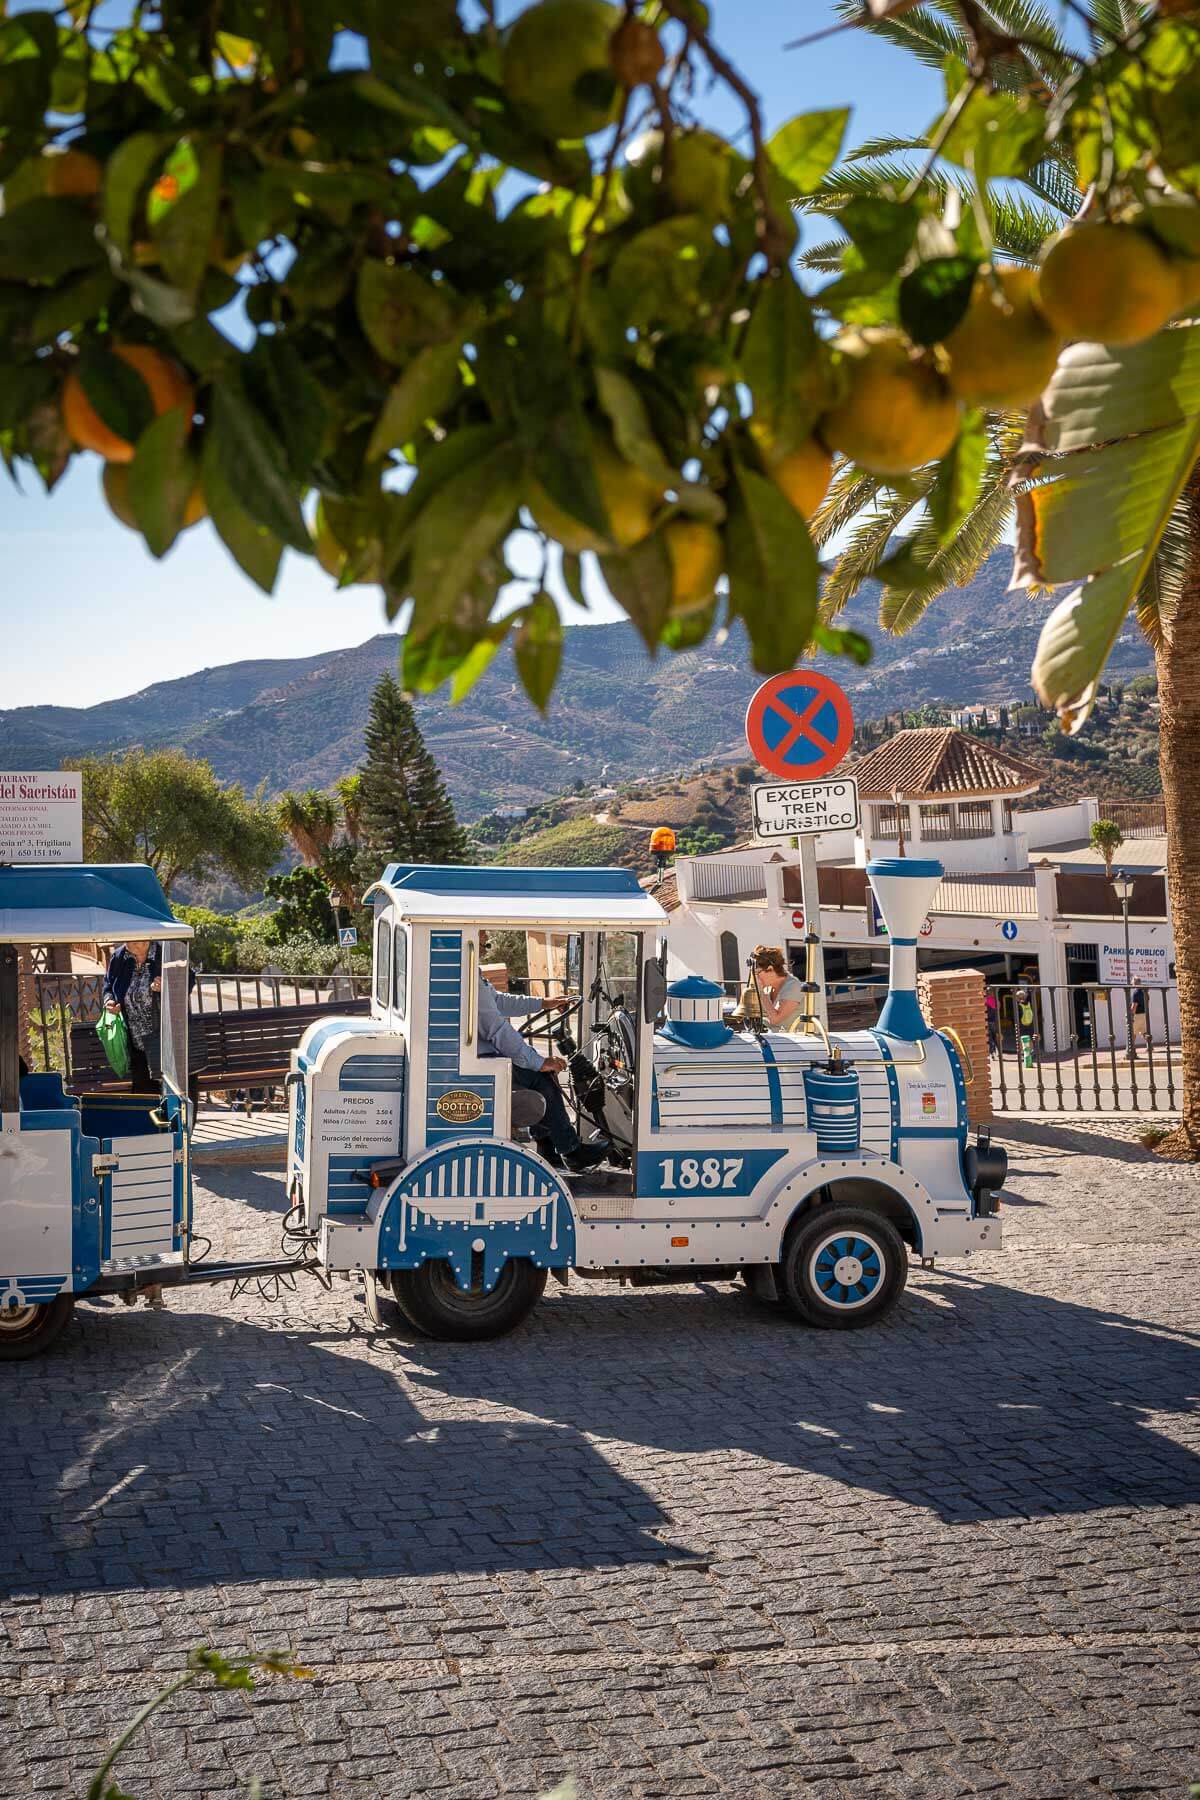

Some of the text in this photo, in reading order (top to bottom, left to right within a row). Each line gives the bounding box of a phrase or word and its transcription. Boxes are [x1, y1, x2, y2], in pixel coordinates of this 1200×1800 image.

[19, 783, 77, 799] Sacristán
[766, 785, 846, 803] EXCEPTO
[782, 801, 827, 815] TREN
[36, 839, 72, 848] Frigiliana
[18, 849, 32, 857] 650
[34, 849, 46, 857] 151
[48, 849, 62, 857] 196
[1104, 945, 1165, 957] PARKIG PUBLICO
[343, 1097, 374, 1105] PRECIOS
[442, 1102, 478, 1111] DOTTO
[658, 1158, 744, 1189] 1887
